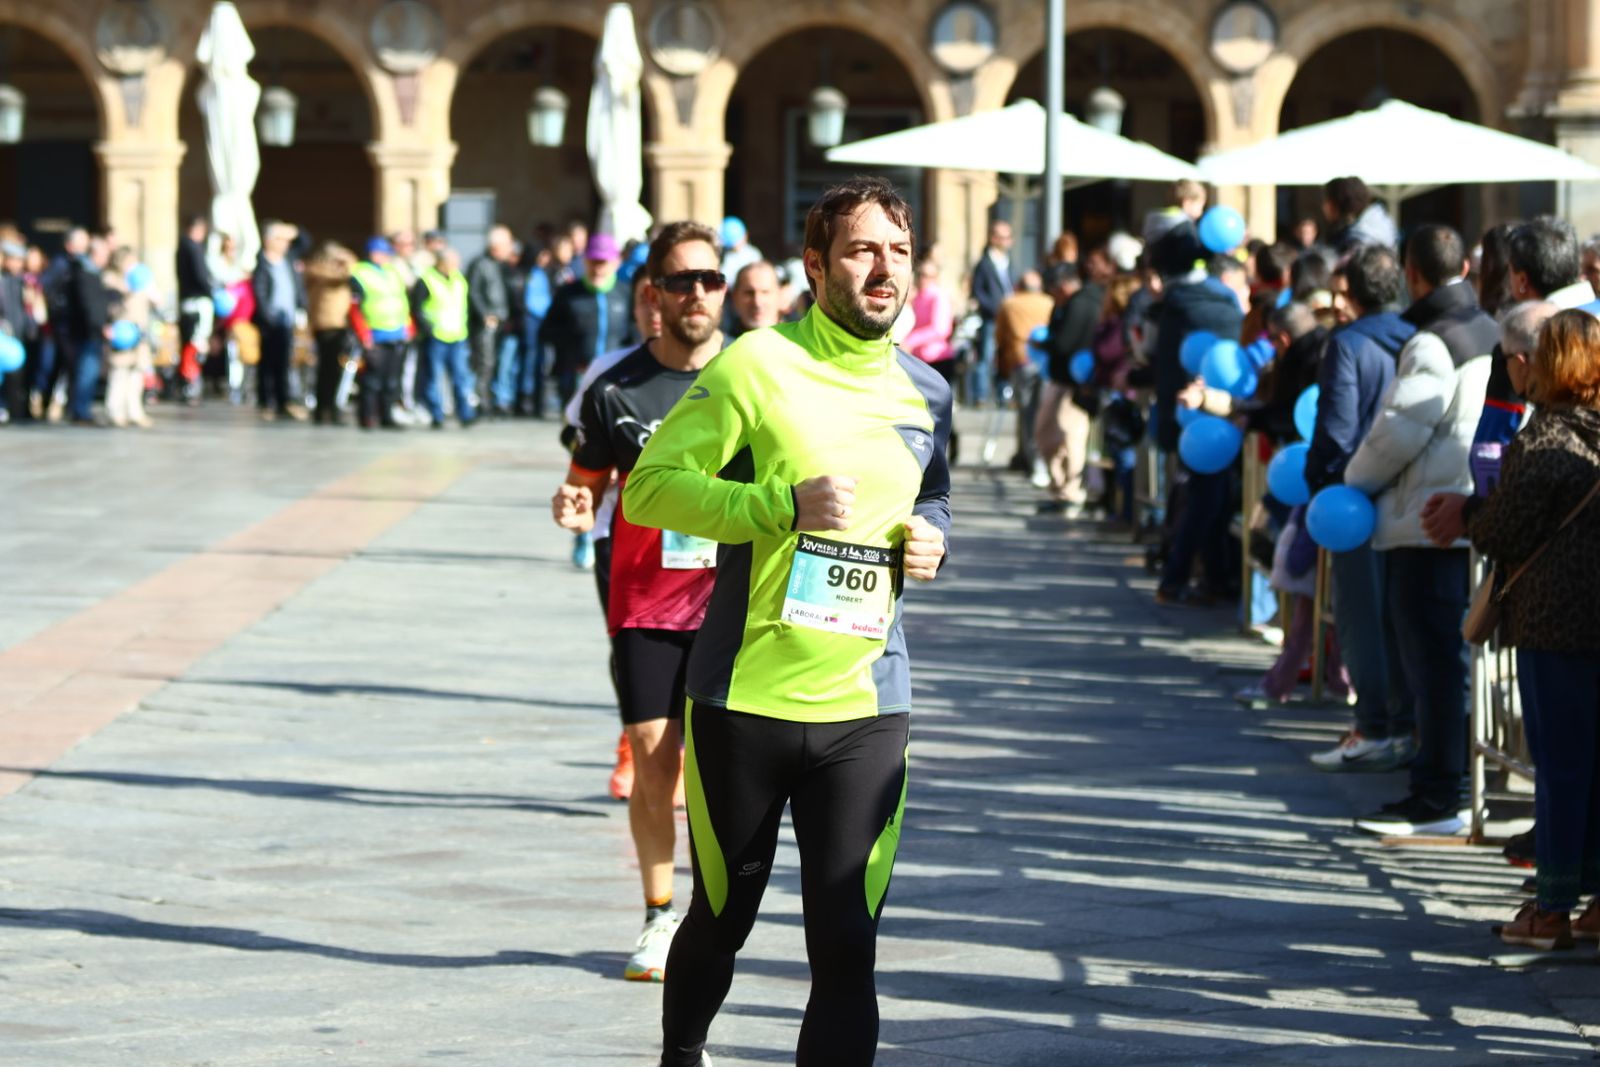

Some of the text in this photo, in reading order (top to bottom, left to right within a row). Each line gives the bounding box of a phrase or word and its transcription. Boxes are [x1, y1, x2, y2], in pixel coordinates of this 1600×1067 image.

[802, 538, 818, 552] XIV
[817, 543, 838, 553] MEDIA
[864, 549, 880, 560] 2026
[826, 564, 878, 593] 960
[835, 594, 864, 604] ROBERT
